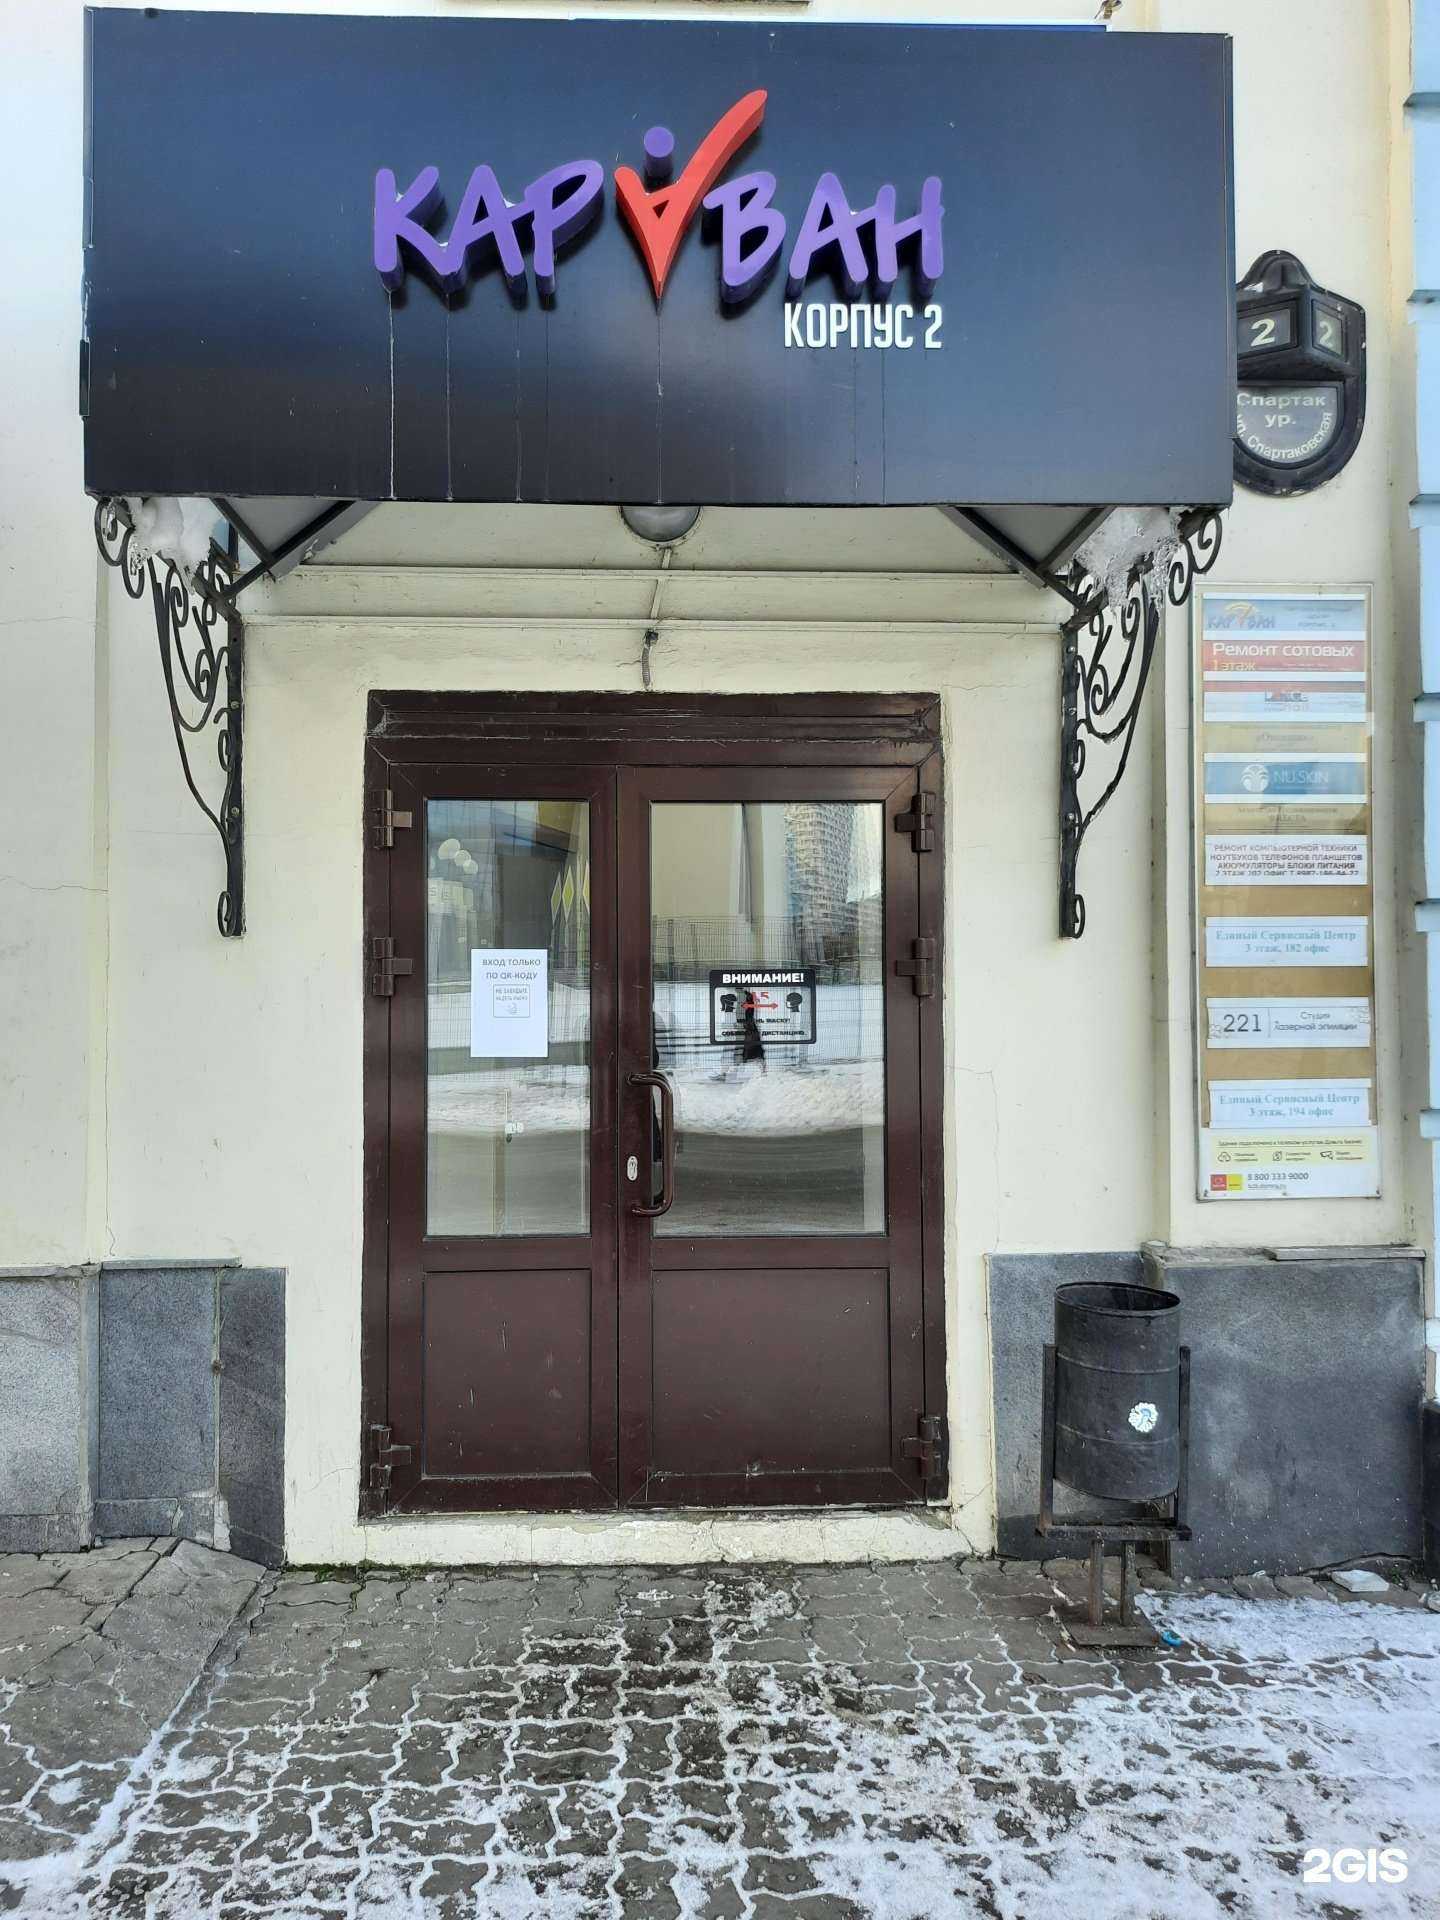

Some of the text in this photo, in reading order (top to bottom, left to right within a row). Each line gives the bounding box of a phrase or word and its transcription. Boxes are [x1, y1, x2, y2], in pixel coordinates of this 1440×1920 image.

[783, 302, 943, 350] КОРПУС 2
[1250, 318, 1276, 347] 2
[1318, 321, 1334, 348] 2
[1237, 393, 1327, 409] Спартак
[1264, 415, 1297, 428] ур.
[1247, 412, 1333, 460] Спартаковская
[1212, 642, 1355, 657] Ремонт сотовых
[1221, 661, 1256, 671] этаж
[1273, 769, 1329, 784] NU SKIN
[1321, 843, 1358, 851] ТЕХНИКИ
[1217, 862, 1285, 870] АККУМУЛЯТОРЫ
[1216, 929, 1356, 942] Единый Сервисный Центр
[1304, 944, 1329, 955] офис
[483, 959, 505, 967] ВХОД
[722, 973, 804, 984] ВНИМАНИЕ!
[1300, 1011, 1330, 1021] Студия
[1223, 1014, 1262, 1033] 221
[1220, 1093, 1360, 1105] Единый Сервисный Центр
[1309, 1108, 1334, 1119] офис
[1288, 1172, 1309, 1180] 9000
